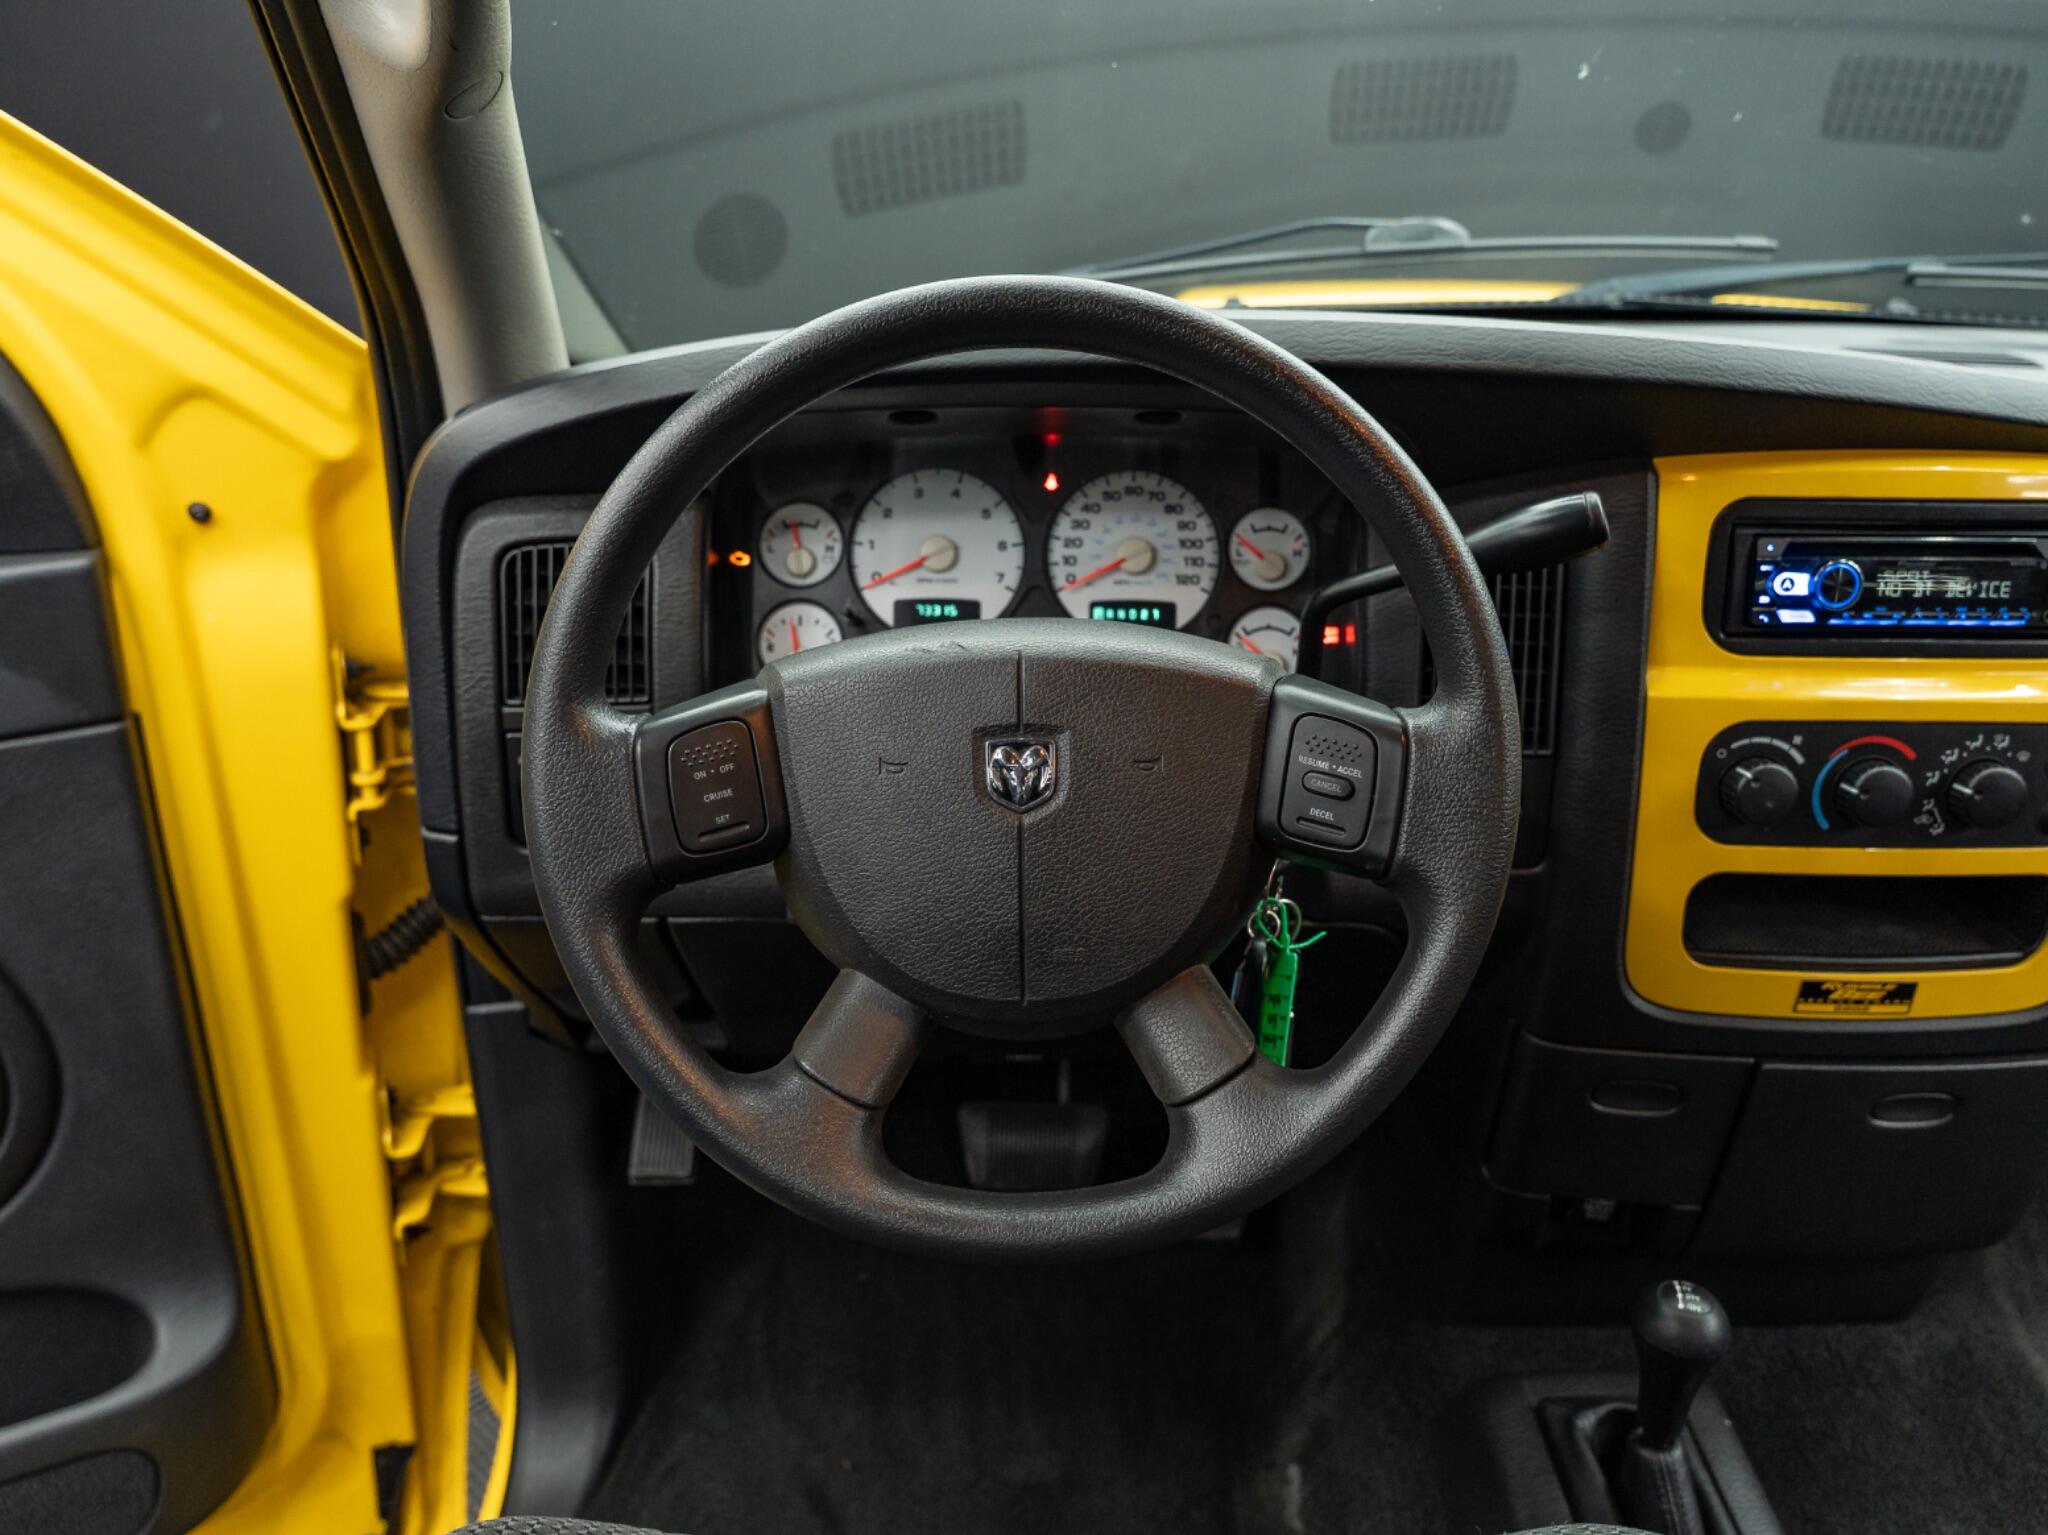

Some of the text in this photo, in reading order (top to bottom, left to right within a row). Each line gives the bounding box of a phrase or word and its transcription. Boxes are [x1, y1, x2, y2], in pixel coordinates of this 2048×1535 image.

[914, 488, 924, 499] 3
[950, 488, 961, 498] 4
[1102, 491, 1122, 502] 50
[1147, 491, 1166, 502] 70
[1081, 503, 1101, 514] 40
[1164, 504, 1184, 514] 80
[1070, 520, 1090, 530] 30
[1177, 520, 1196, 531] 90
[997, 541, 1008, 551] 6
[1063, 538, 1083, 548] 20
[1179, 538, 1204, 550] 100
[1062, 556, 1077, 566] 10
[1184, 556, 1205, 568] 110
[995, 572, 1006, 584] 7
[1176, 574, 1200, 586] 120
[694, 762, 736, 780] ON OFF
[1298, 755, 1363, 778] RESUME ACCEL
[1310, 778, 1342, 793] CANCEL
[703, 788, 734, 802] CRUISE
[715, 814, 730, 824] SET
[1309, 807, 1334, 821] DECEL
